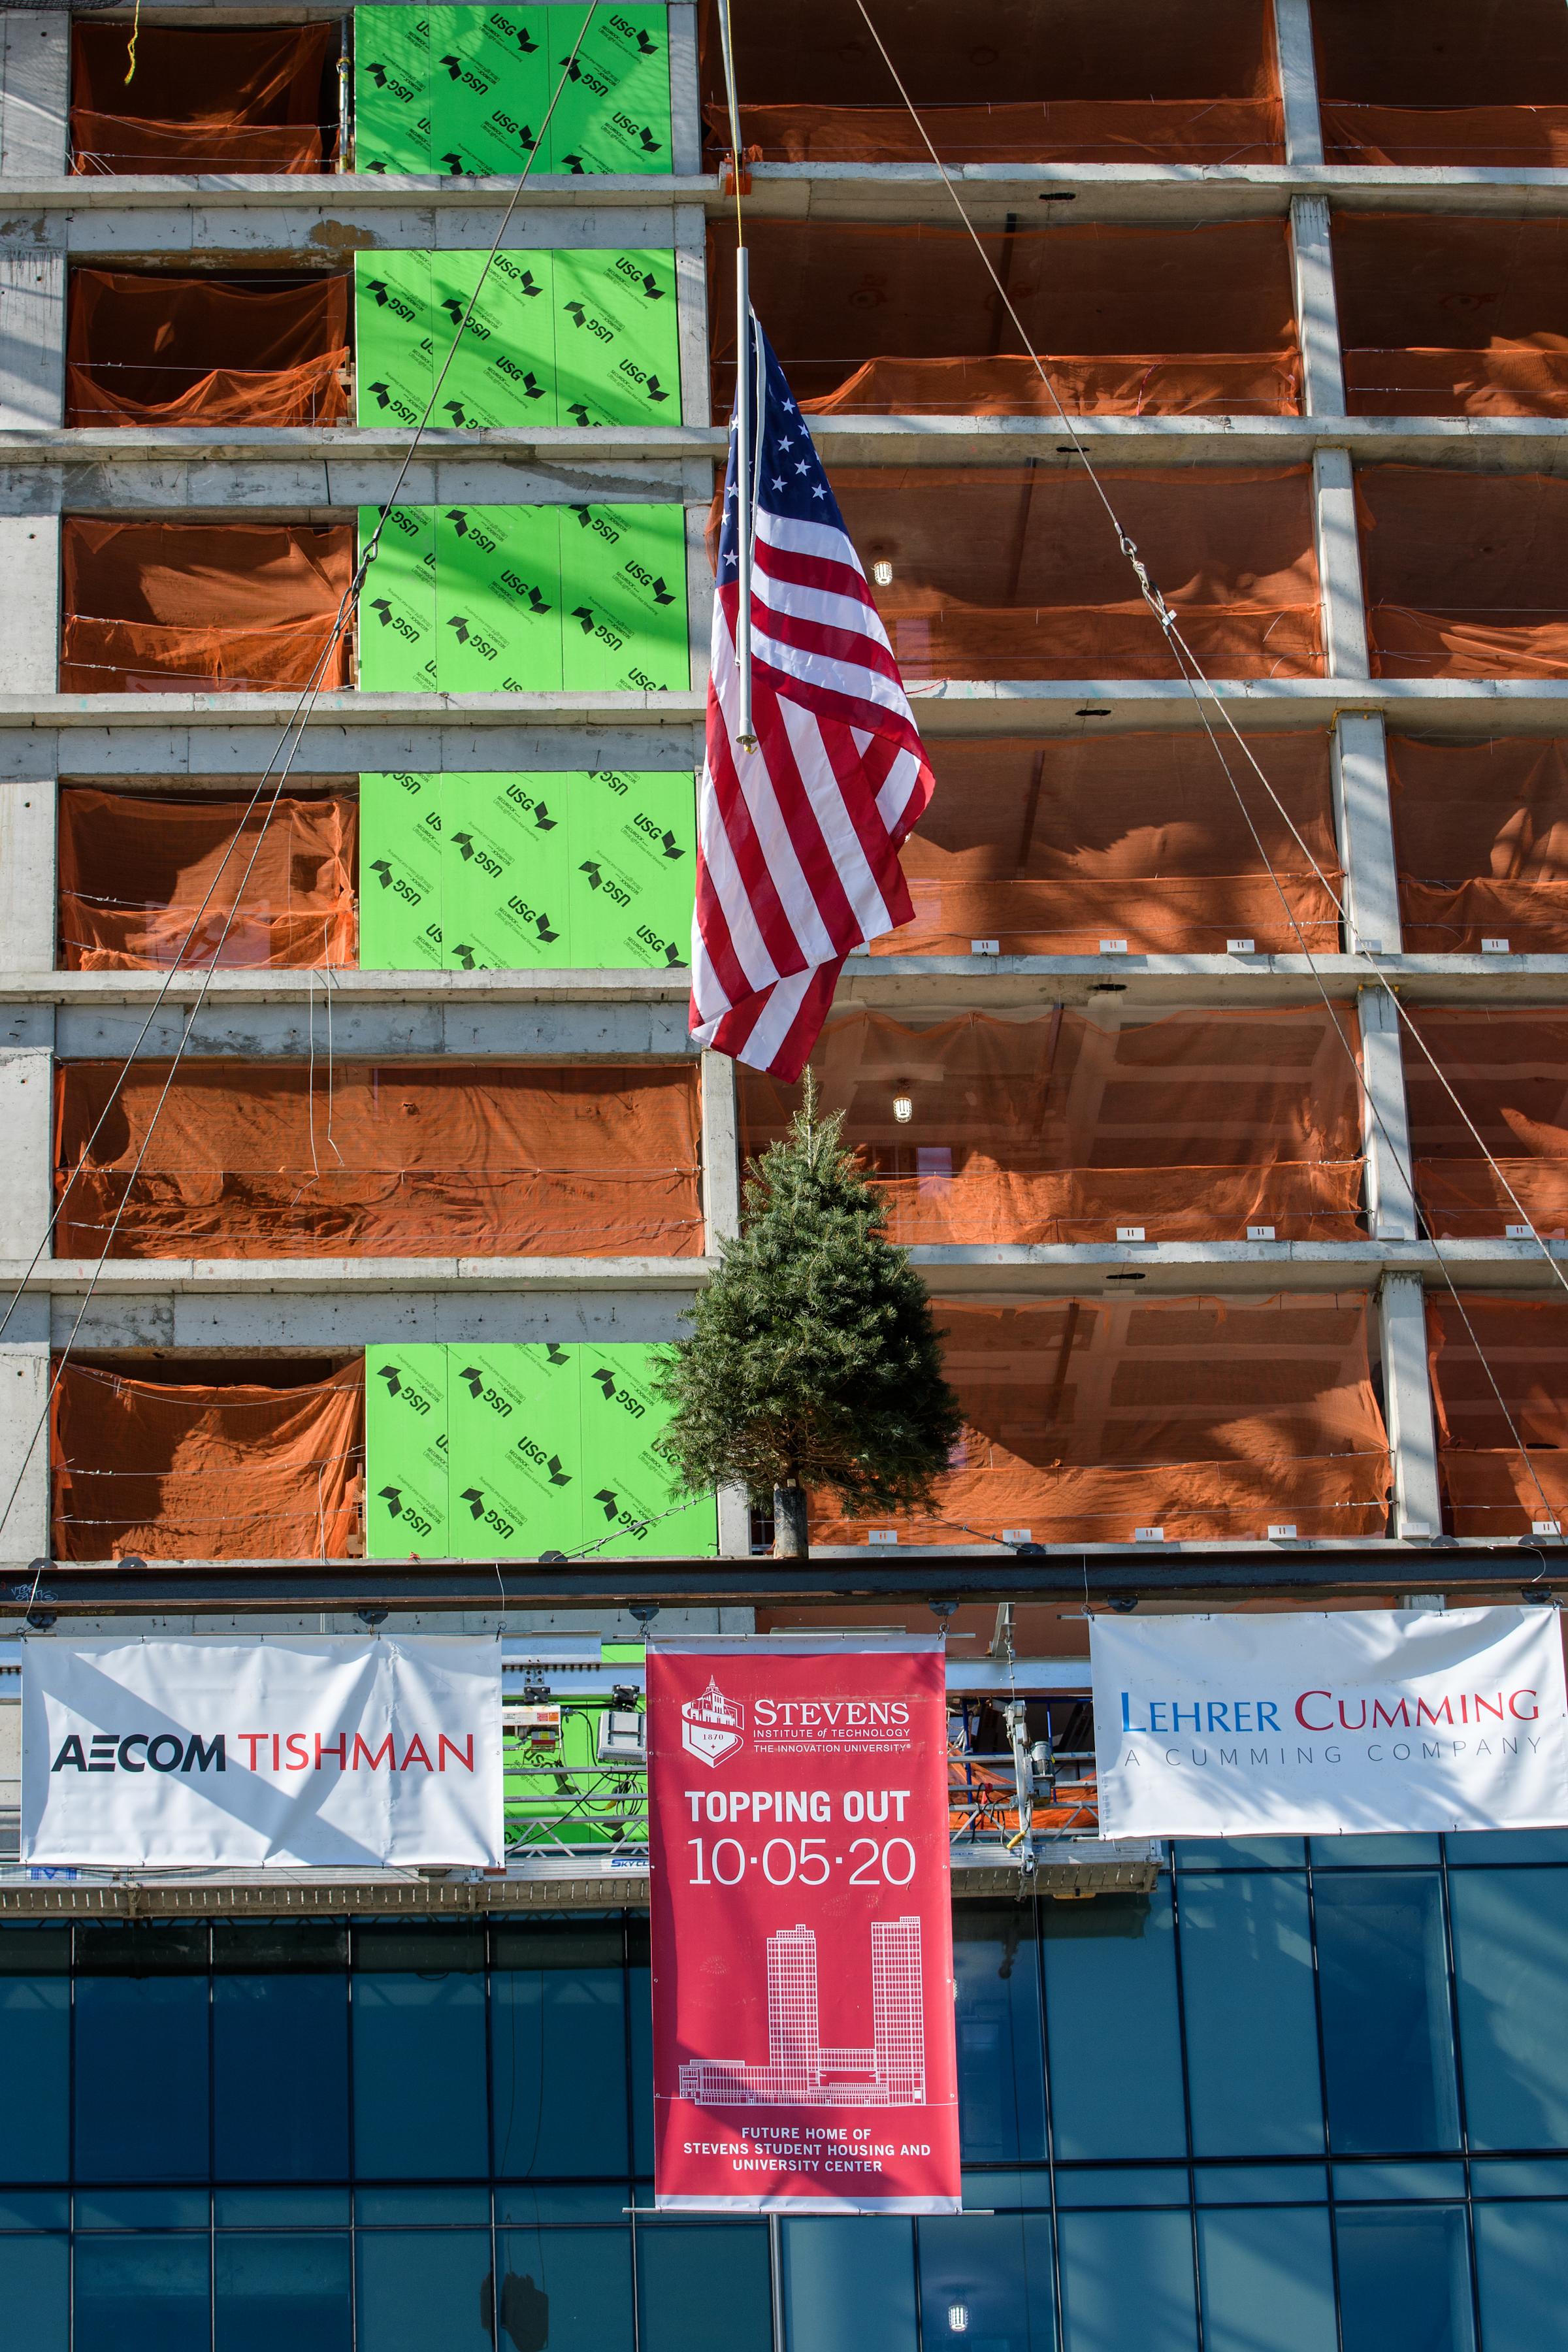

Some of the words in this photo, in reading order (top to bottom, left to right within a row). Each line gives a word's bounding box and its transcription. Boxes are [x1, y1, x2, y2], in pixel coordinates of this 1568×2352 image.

[491, 14, 517, 37] USG
[610, 15, 636, 38] USG
[387, 80, 415, 104] USG
[462, 72, 489, 95] USG
[581, 74, 609, 97] USG
[492, 110, 519, 134] USG
[612, 112, 640, 136] USG
[494, 255, 522, 280] USG
[616, 257, 643, 282] USG
[388, 298, 416, 323] USG
[464, 316, 491, 341] USG
[587, 319, 614, 344] USG
[496, 356, 524, 382] USG
[619, 359, 647, 384] USG
[390, 400, 417, 426] USG
[391, 512, 419, 538] USG
[592, 519, 620, 545] USG
[468, 529, 496, 554] USG
[501, 570, 529, 596] USG
[625, 561, 653, 587] USG
[393, 617, 421, 644] USG
[595, 625, 623, 651] USG
[470, 635, 498, 661] USG
[629, 668, 656, 692] USG
[506, 785, 534, 811] USG
[634, 813, 662, 840] USG
[475, 852, 503, 879] USG
[393, 879, 421, 907] USG
[603, 881, 631, 907] USG
[508, 896, 536, 923] USG
[636, 925, 665, 953] USG
[402, 1387, 431, 1416] USG
[483, 1388, 513, 1418] USG
[616, 1390, 645, 1419] USG
[518, 1437, 547, 1465] USG
[402, 1508, 432, 1537] USG
[485, 1510, 514, 1539] USG
[754, 1699, 909, 1725] STEVENS
[1121, 1692, 1281, 1732] LEHRER
[1295, 1690, 1539, 1731] CUMMING
[753, 1729, 813, 1738] INSTITUTE
[817, 1728, 827, 1739] of
[832, 1728, 910, 1738] TECHNOLOGY
[51, 1734, 226, 1772] AECOM
[238, 1733, 474, 1772] TISHMAN
[754, 1744, 774, 1753] THE
[777, 1744, 840, 1753] INNOVATION
[1124, 1749, 1140, 1767] A
[1166, 1746, 1341, 1766] CUMMING
[1368, 1737, 1541, 1762] COMPANY
[685, 1791, 831, 1822] TOPPING
[843, 1791, 910, 1822] OUT
[742, 2127, 800, 2139] FUTURE
[806, 2128, 847, 2140] HOME
[853, 2129, 872, 2140] OF
[683, 2142, 749, 2155] STEVENS
[754, 2143, 822, 2155] STUDENT
[828, 2144, 894, 2156] HOUSING
[900, 2144, 931, 2156] AND
[733, 2159, 819, 2172] UNIVERSITY
[825, 2160, 883, 2172] CENTER
